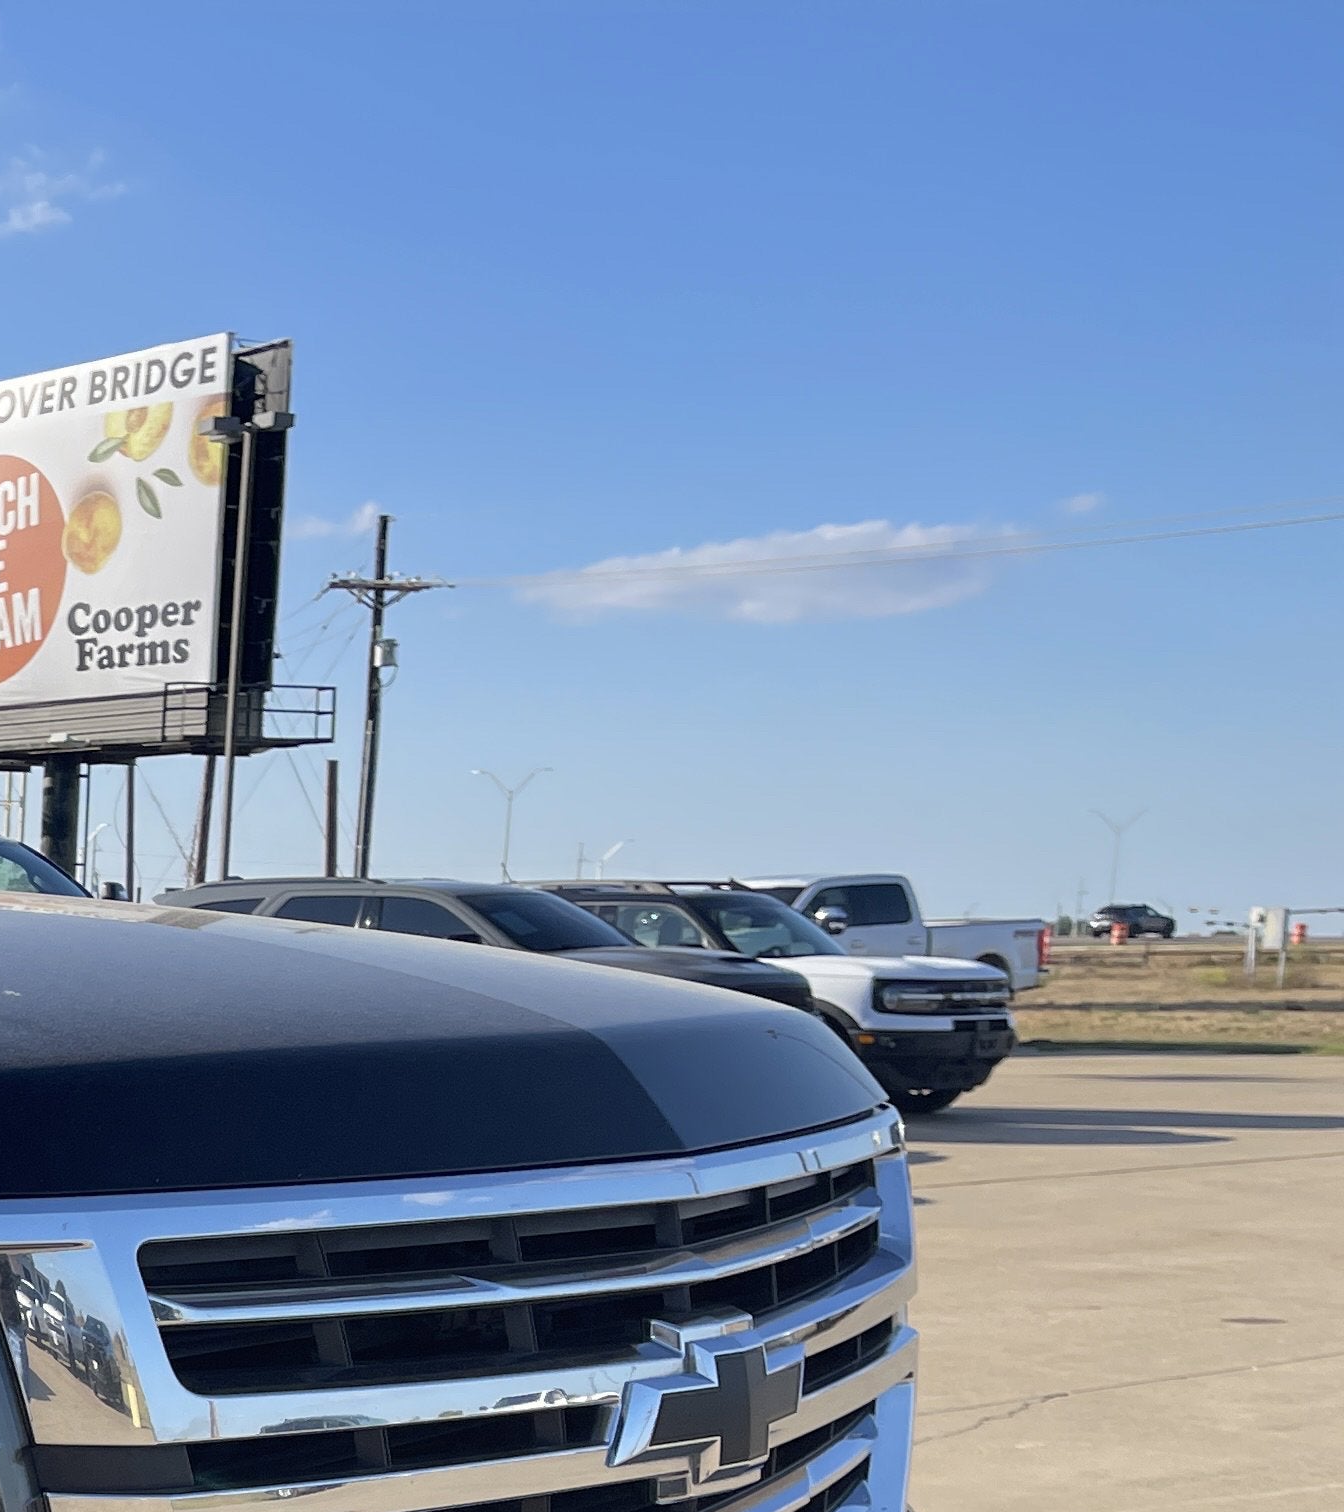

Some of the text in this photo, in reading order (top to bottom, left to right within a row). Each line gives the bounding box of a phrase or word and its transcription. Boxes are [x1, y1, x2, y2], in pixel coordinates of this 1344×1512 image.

[86, 346, 219, 404] BRIDGE
[67, 599, 202, 638] Cooper
[75, 636, 190, 672] Farms
